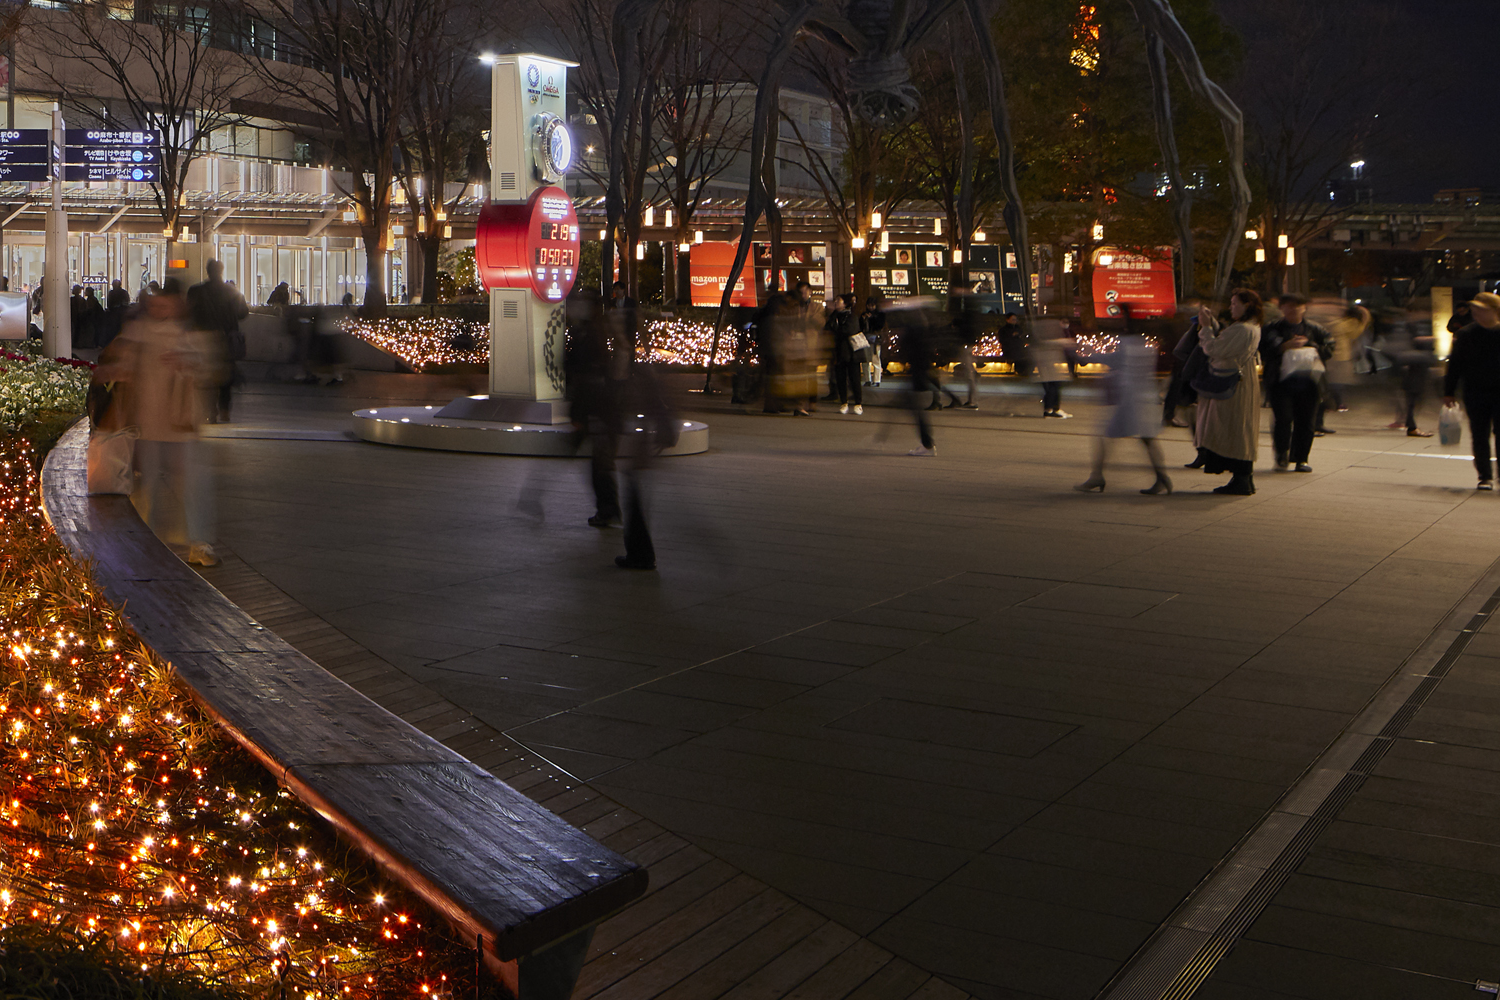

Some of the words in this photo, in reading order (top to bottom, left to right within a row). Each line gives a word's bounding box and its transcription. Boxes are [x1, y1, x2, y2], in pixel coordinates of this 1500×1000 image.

[550, 223, 569, 241] 219
[691, 275, 718, 284] mazon
[718, 275, 744, 283] mic
